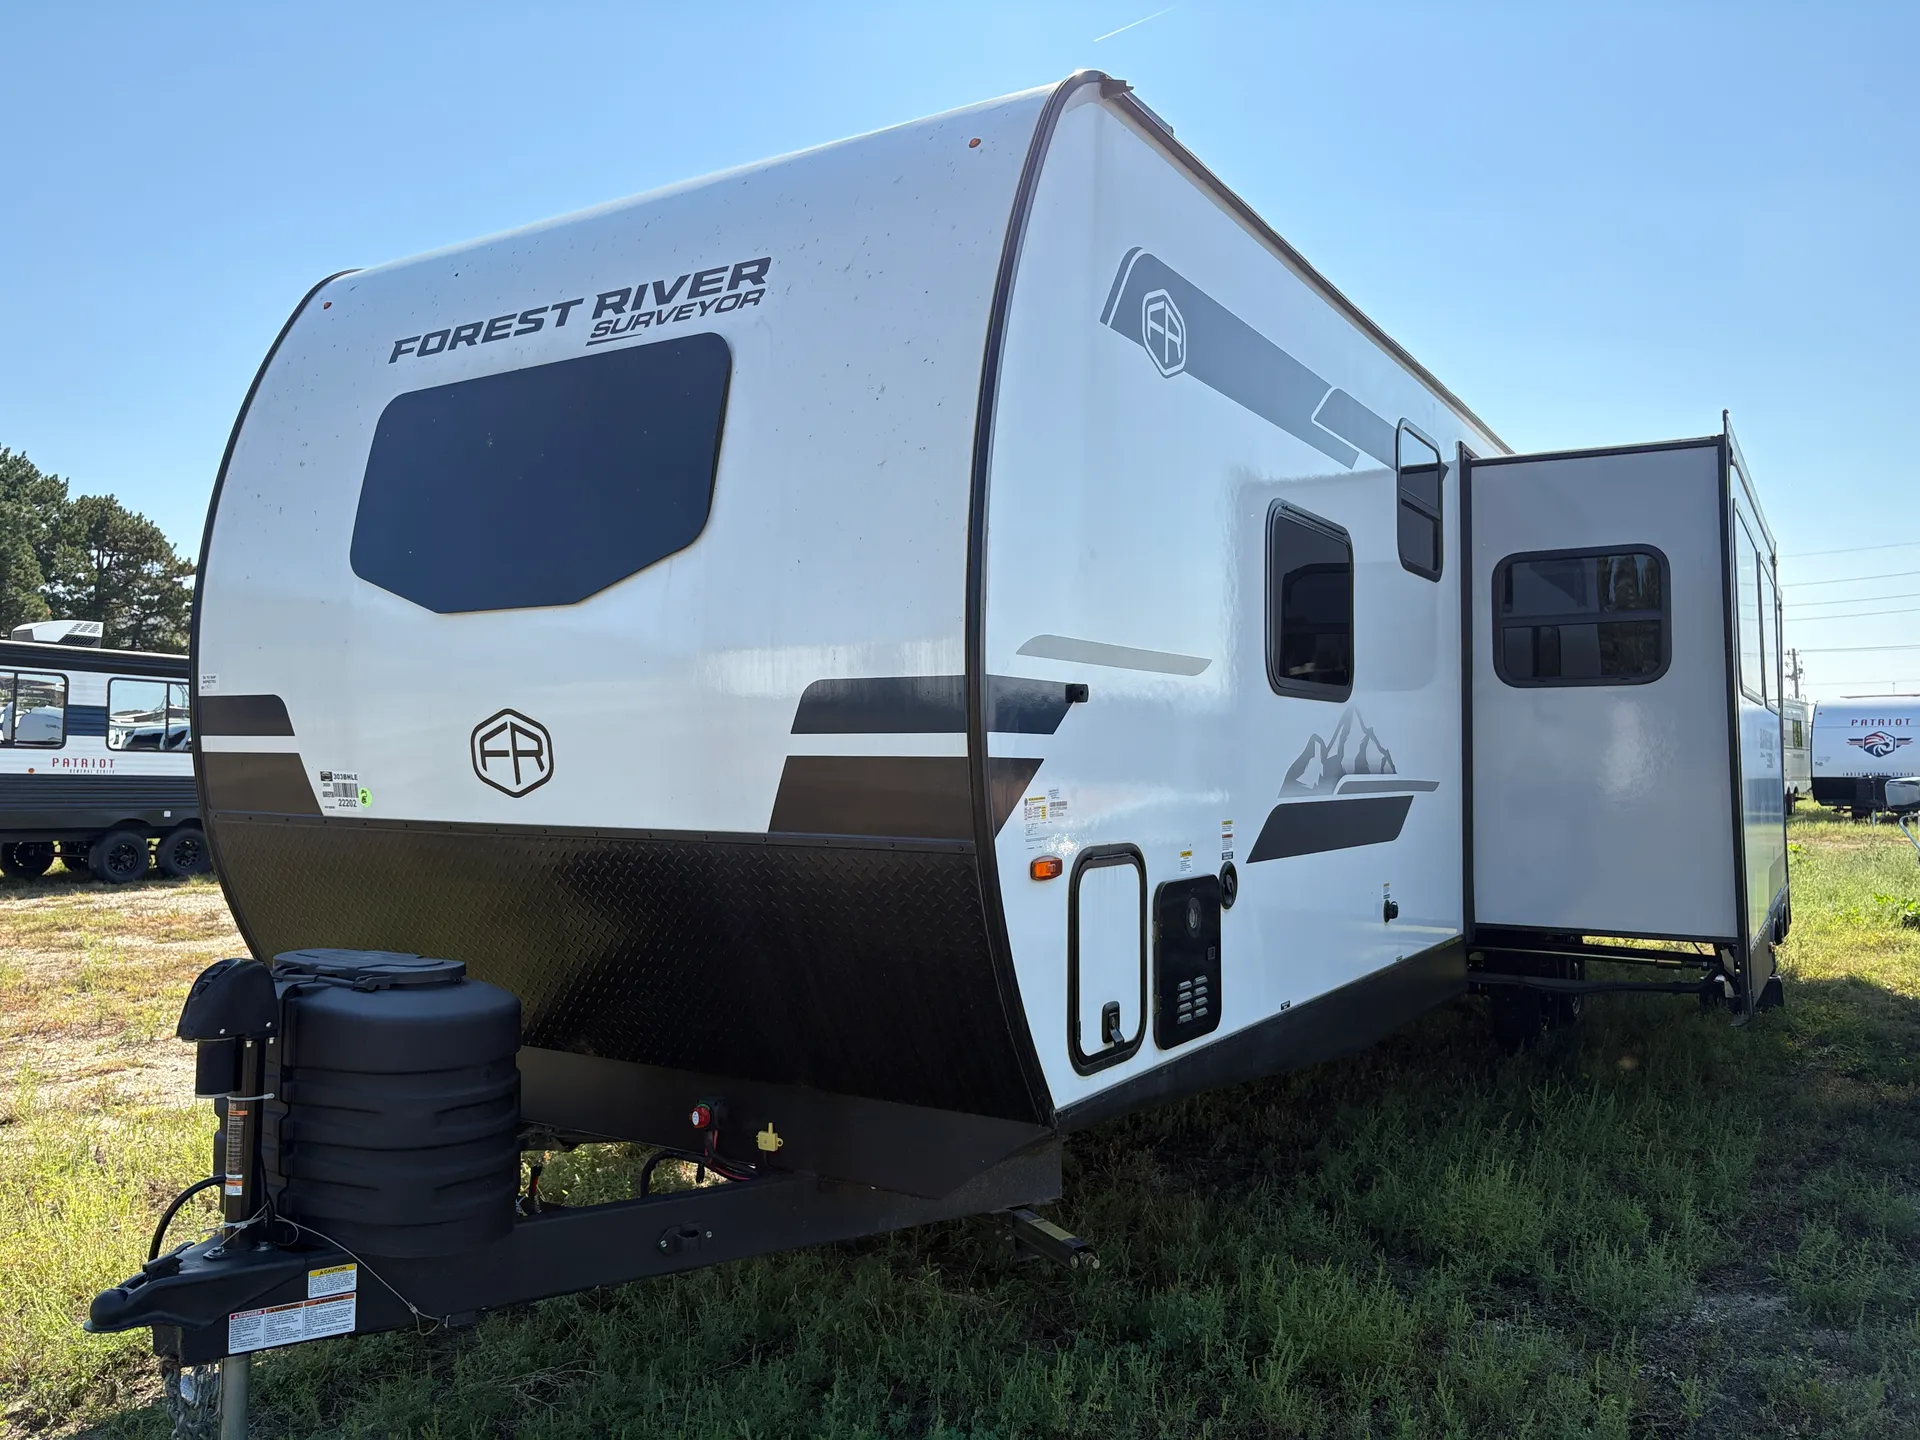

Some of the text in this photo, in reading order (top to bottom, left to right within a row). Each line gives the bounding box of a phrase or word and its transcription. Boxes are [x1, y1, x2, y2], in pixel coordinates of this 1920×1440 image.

[388, 256, 772, 365] FOREST RIVER
[590, 288, 766, 339] SURVEYOR
[1851, 718, 1911, 726] PATRIOT
[52, 757, 115, 769] PATRIOT
[338, 798, 358, 808] 22202
